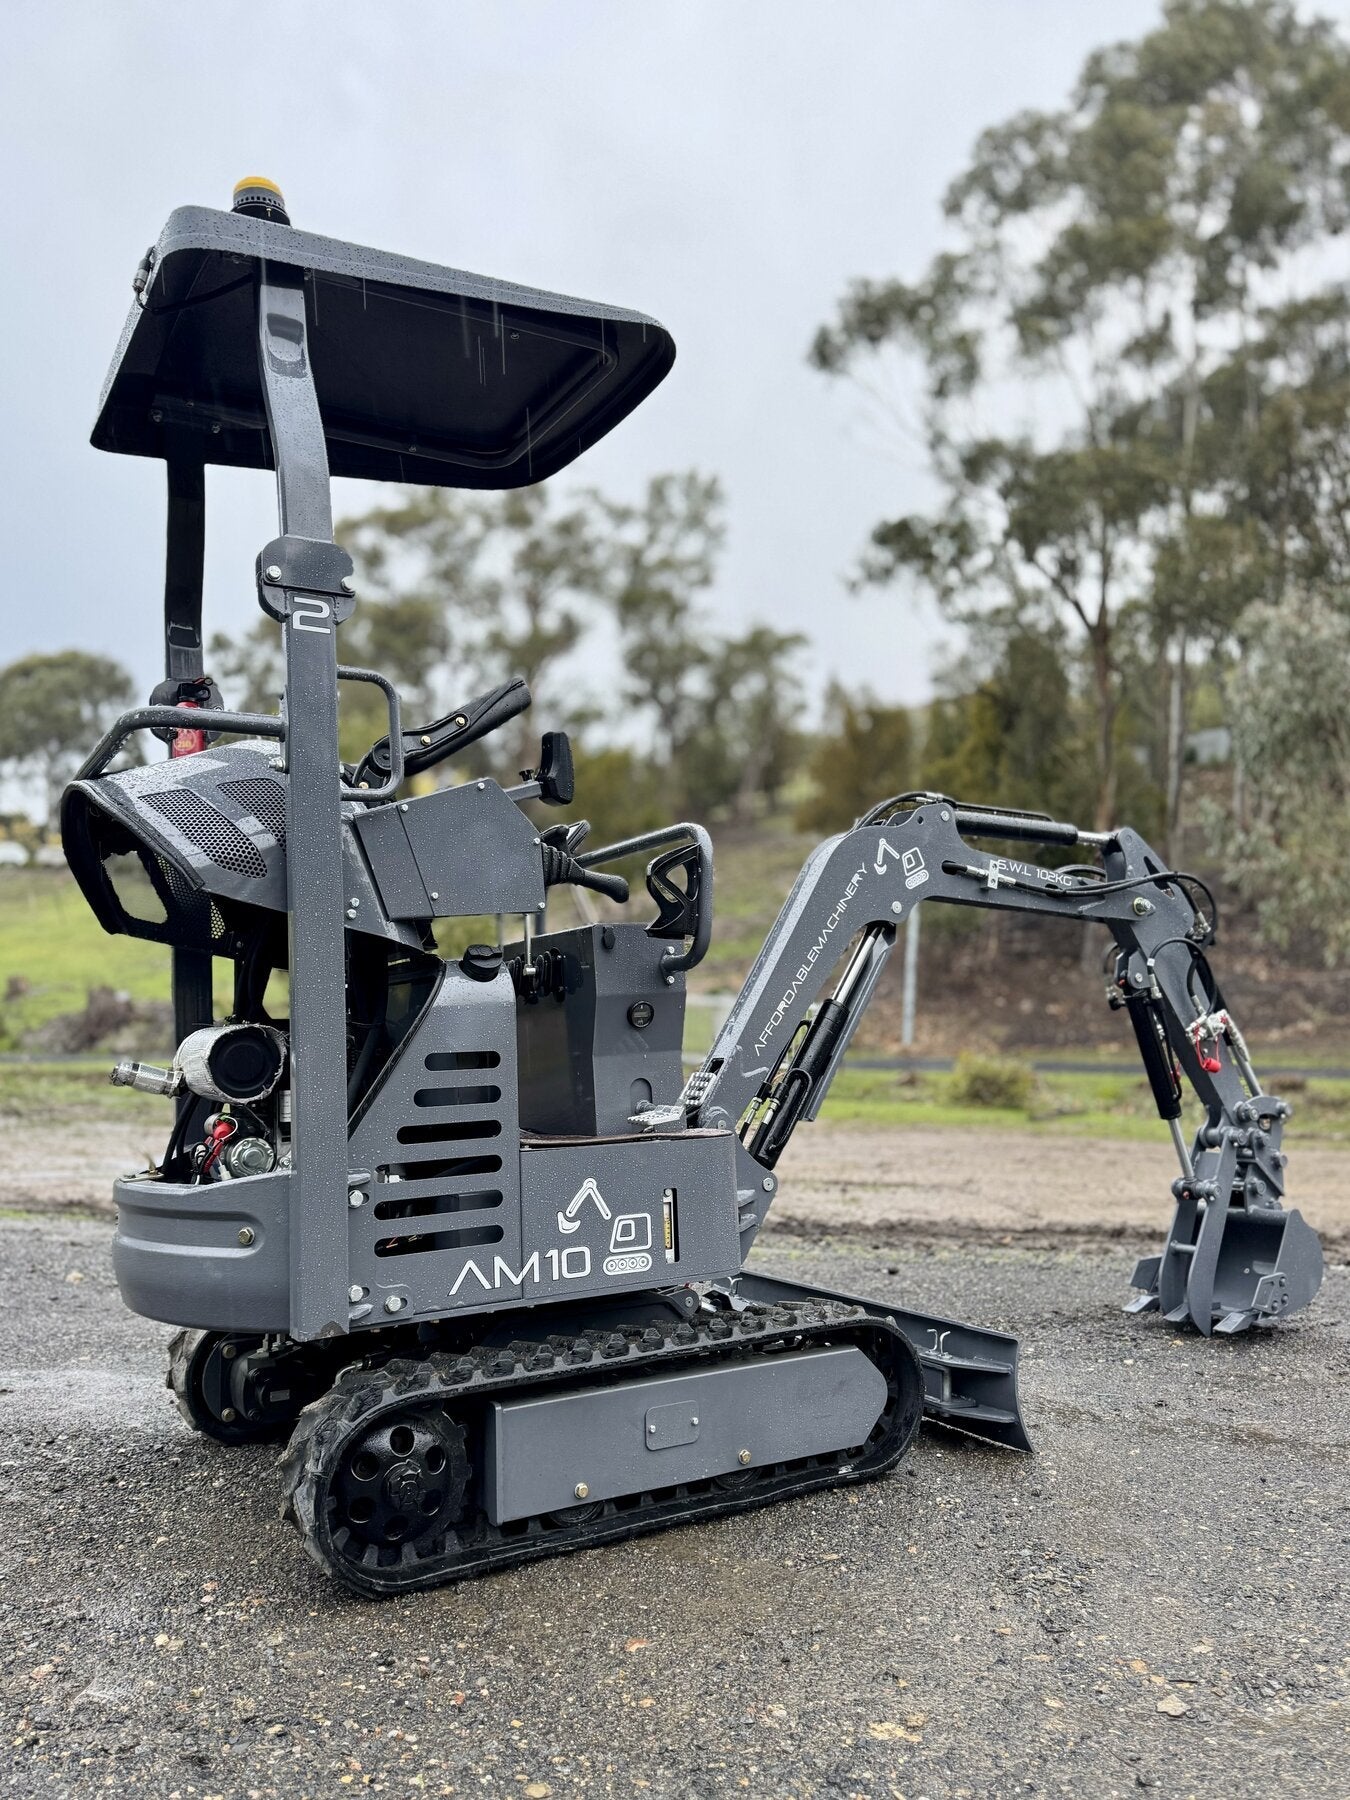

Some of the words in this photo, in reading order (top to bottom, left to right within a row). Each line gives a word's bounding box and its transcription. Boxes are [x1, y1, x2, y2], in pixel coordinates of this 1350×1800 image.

[293, 597, 331, 634] 2
[1036, 868, 1072, 886] 102KG
[754, 862, 868, 1056] AFFORDABLEMACHINERY
[448, 1246, 591, 1297] AM10
